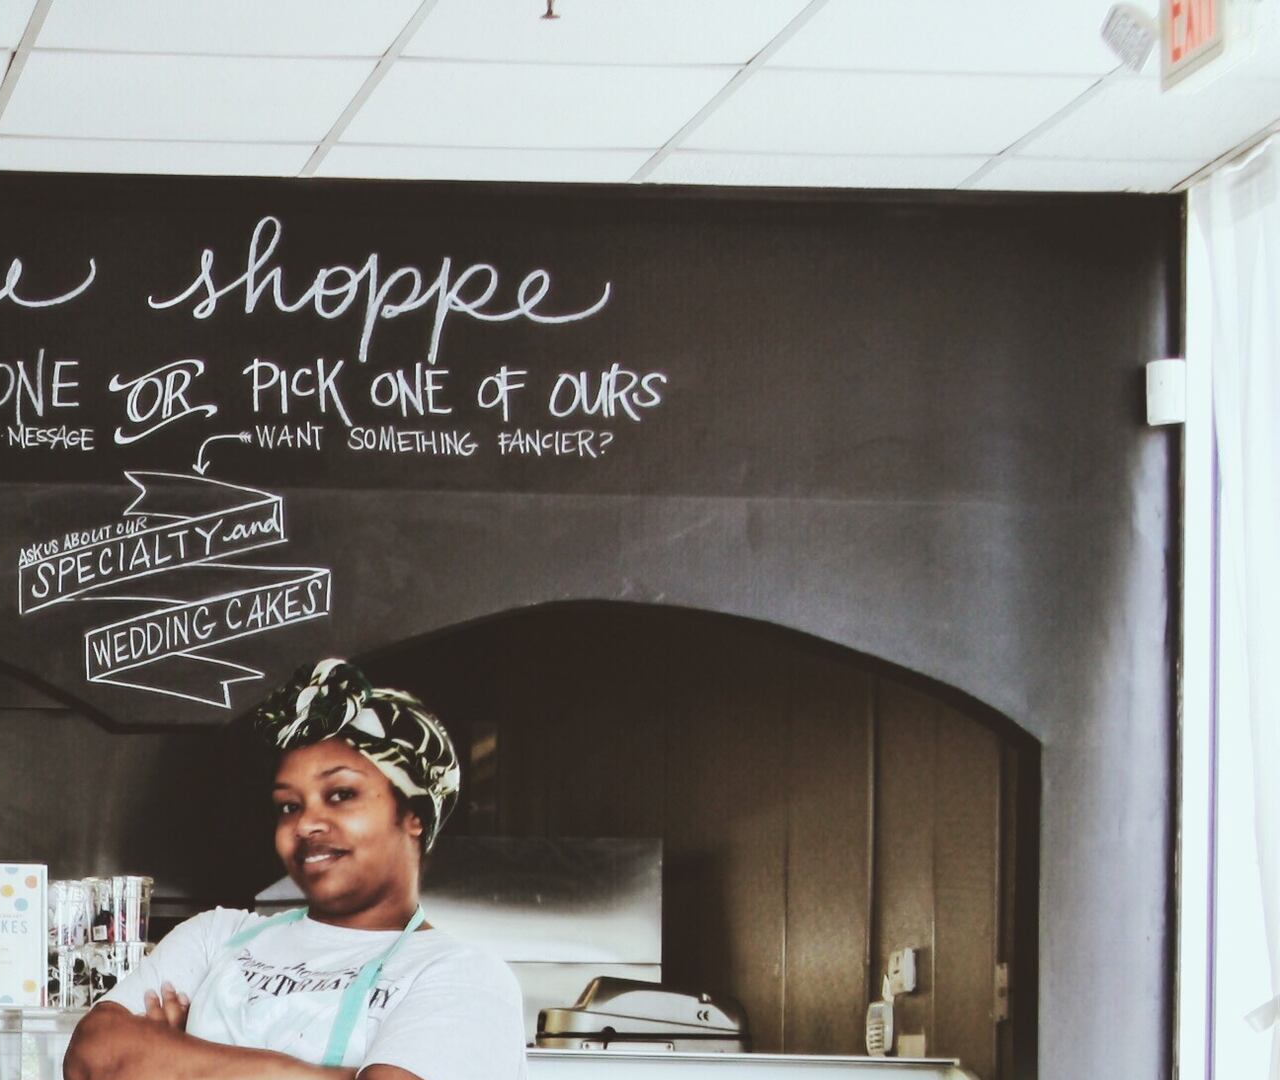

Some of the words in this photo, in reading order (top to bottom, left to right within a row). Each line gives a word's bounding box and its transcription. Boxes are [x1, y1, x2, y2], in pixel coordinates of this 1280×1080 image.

[148, 216, 610, 363] shoppe
[116, 362, 210, 436] OR
[244, 358, 352, 426] PICK
[370, 363, 452, 416] ONE
[477, 367, 527, 421] OF
[549, 363, 667, 420] OURS
[8, 423, 95, 451] MESSAGE
[255, 422, 323, 451] WANT
[348, 426, 478, 455] SOMETHING
[498, 430, 614, 457] FANCIER?
[32, 520, 222, 599] SPECIALTY
[223, 502, 281, 542] and
[64, 525, 112, 551] ABOUT
[117, 516, 148, 536] OUR
[92, 607, 216, 669] WEDDING
[226, 579, 324, 629] CAKES
